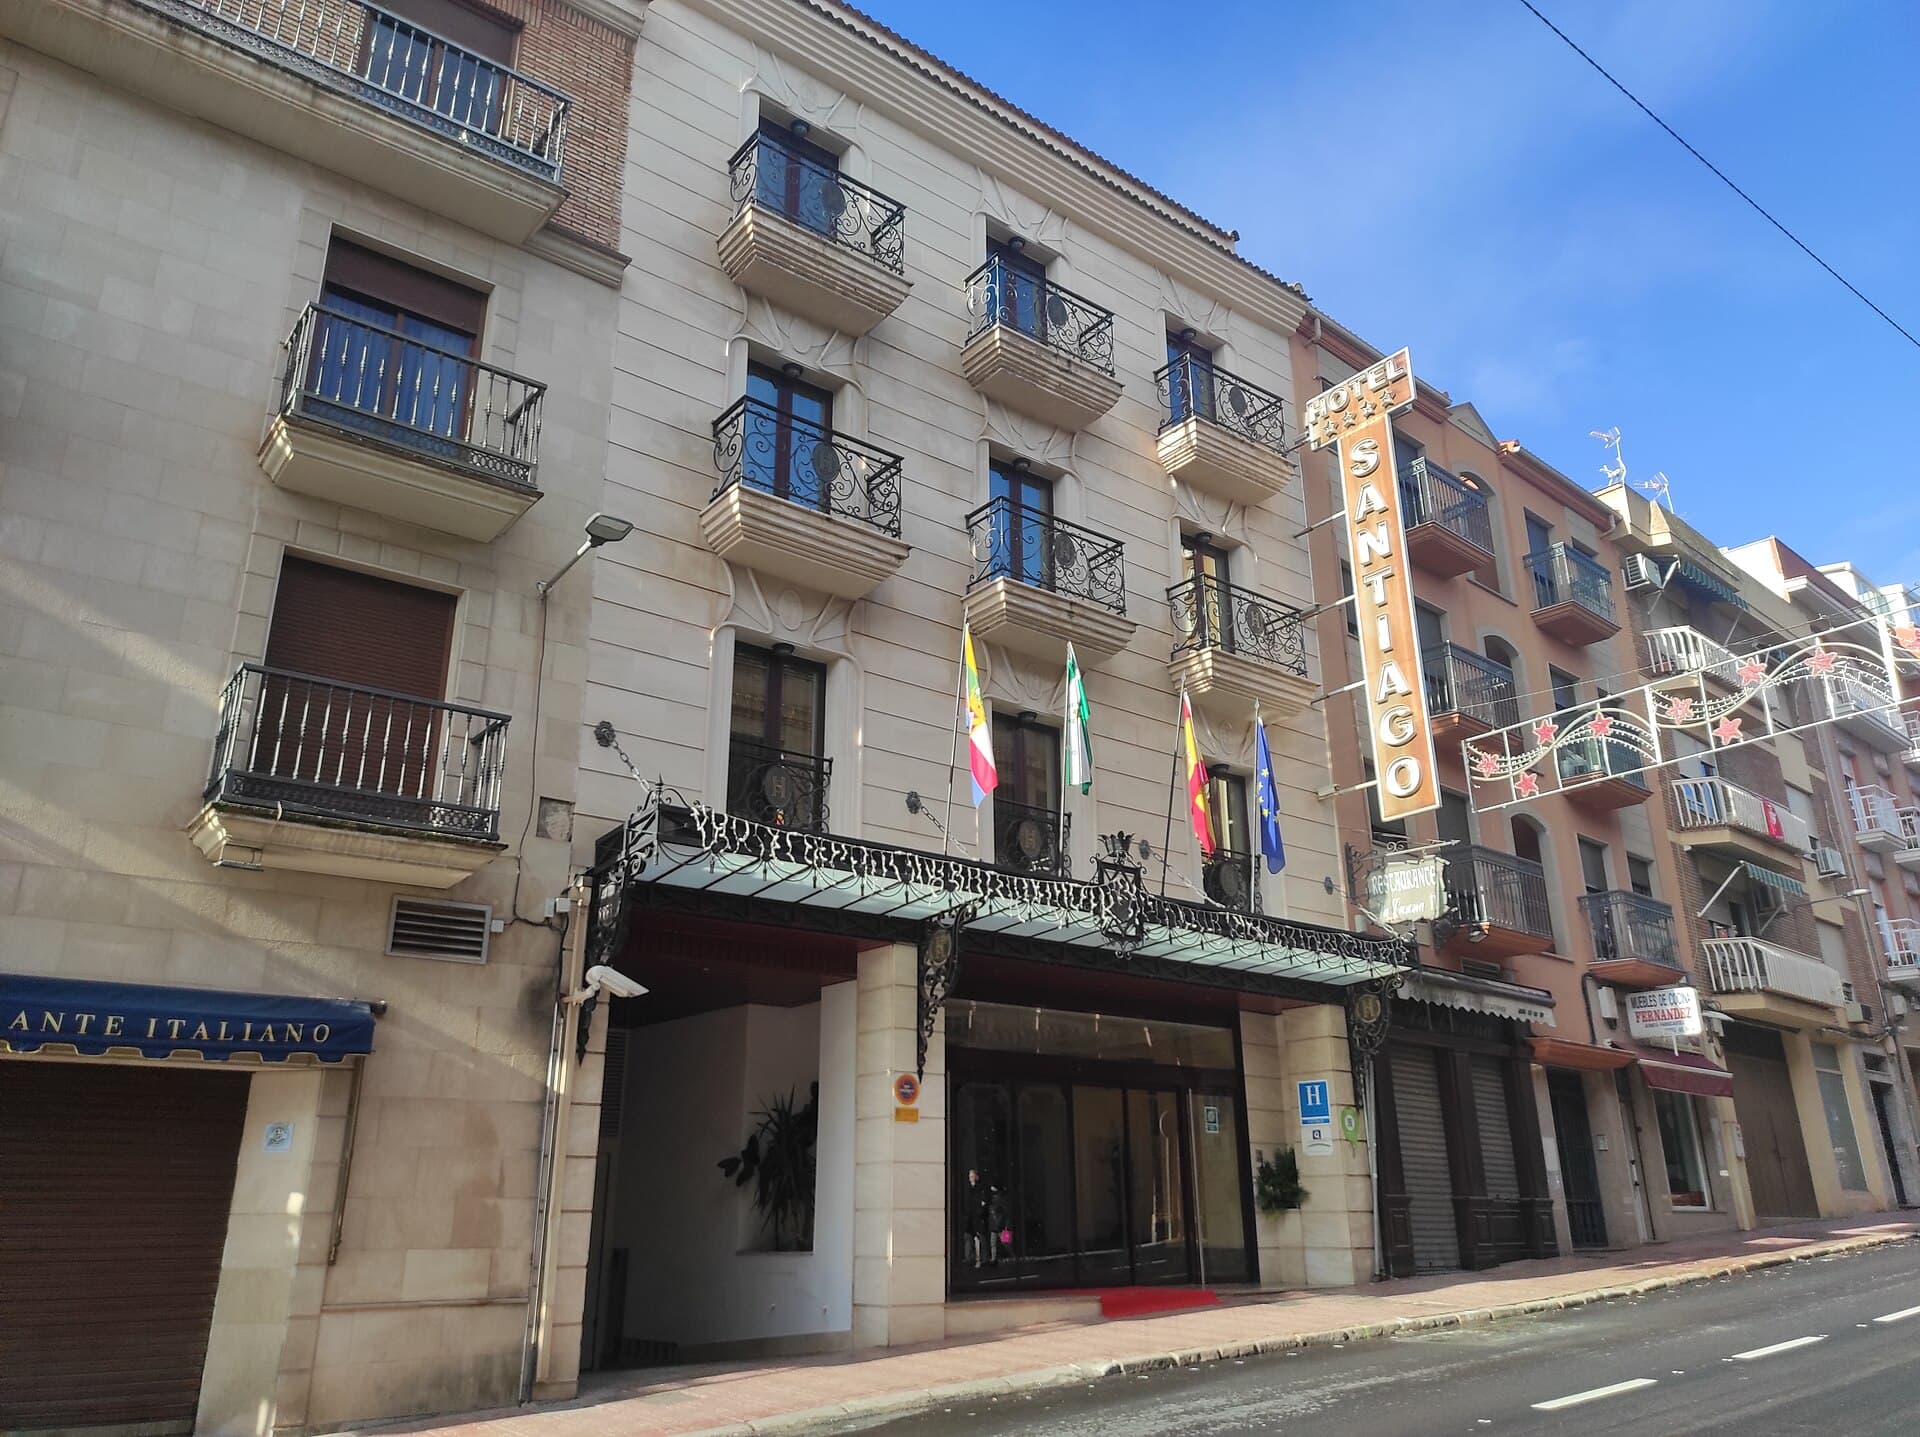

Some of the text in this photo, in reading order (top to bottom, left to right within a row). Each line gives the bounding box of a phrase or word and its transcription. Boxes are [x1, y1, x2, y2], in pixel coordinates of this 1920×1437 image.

[1307, 359, 1408, 426] HOTEL
[1349, 438, 1423, 799] SANTIAGO
[1630, 994, 1657, 1008] MUEBLES
[1659, 993, 1668, 1006] DE
[1635, 1007, 1692, 1022] FERNANDEZ
[146, 1017, 331, 1043] ITALIANO
[1305, 1085, 1321, 1106] H
